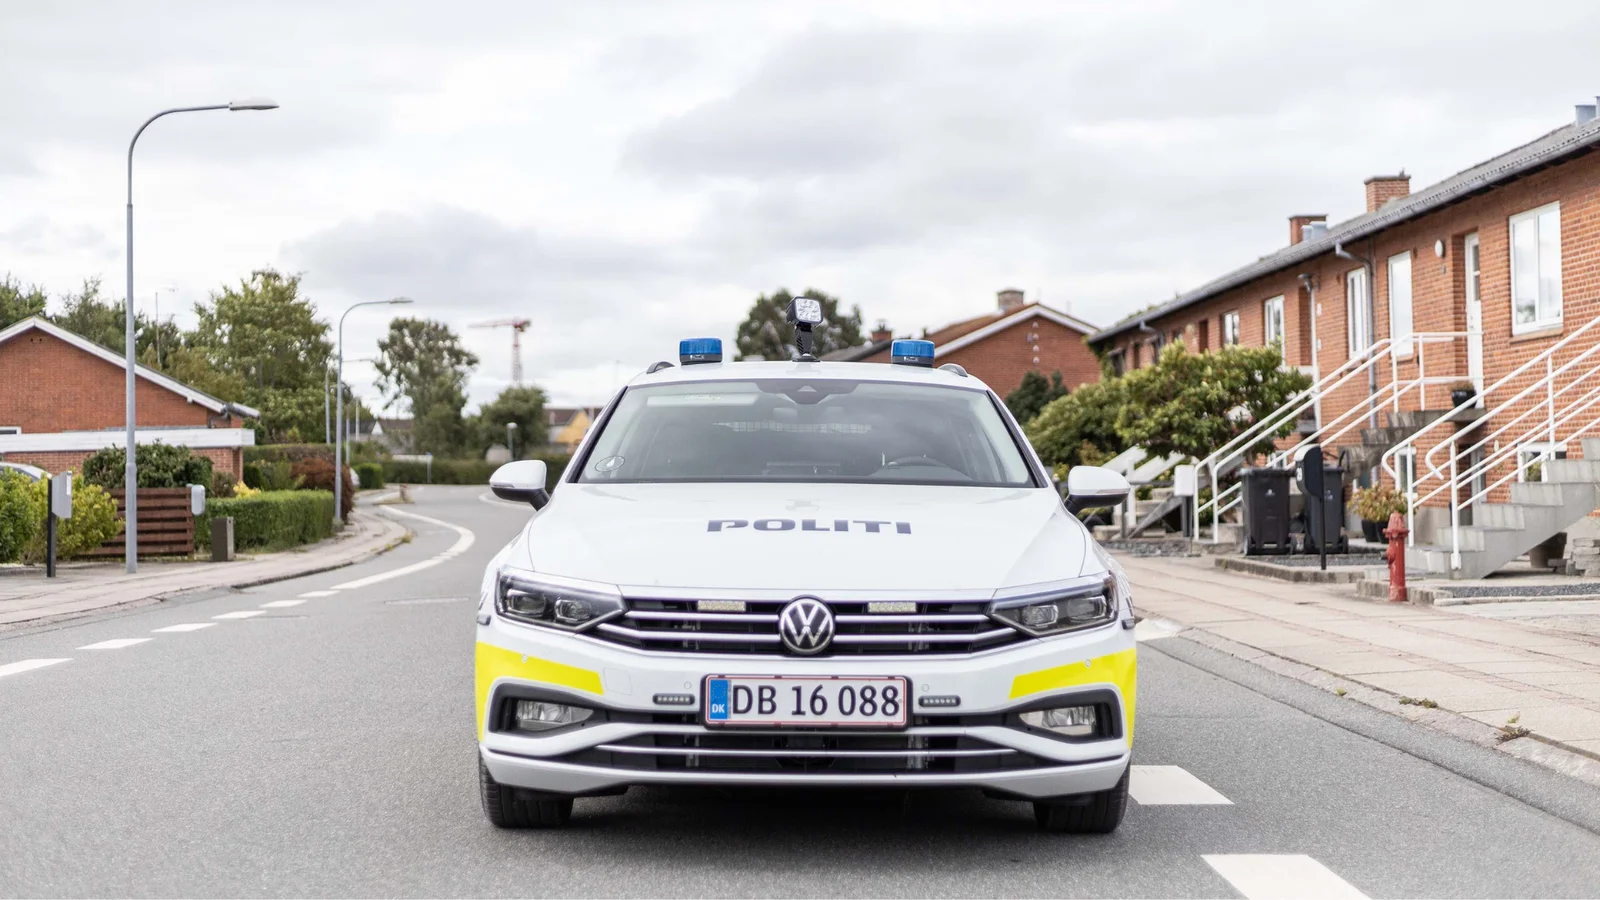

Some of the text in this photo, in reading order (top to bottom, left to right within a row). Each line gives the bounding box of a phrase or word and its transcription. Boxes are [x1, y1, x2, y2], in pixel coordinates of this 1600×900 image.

[706, 519, 912, 534] POLITI
[781, 598, 834, 652] VW
[711, 703, 725, 714] DK
[732, 684, 900, 716] DB 16 088
